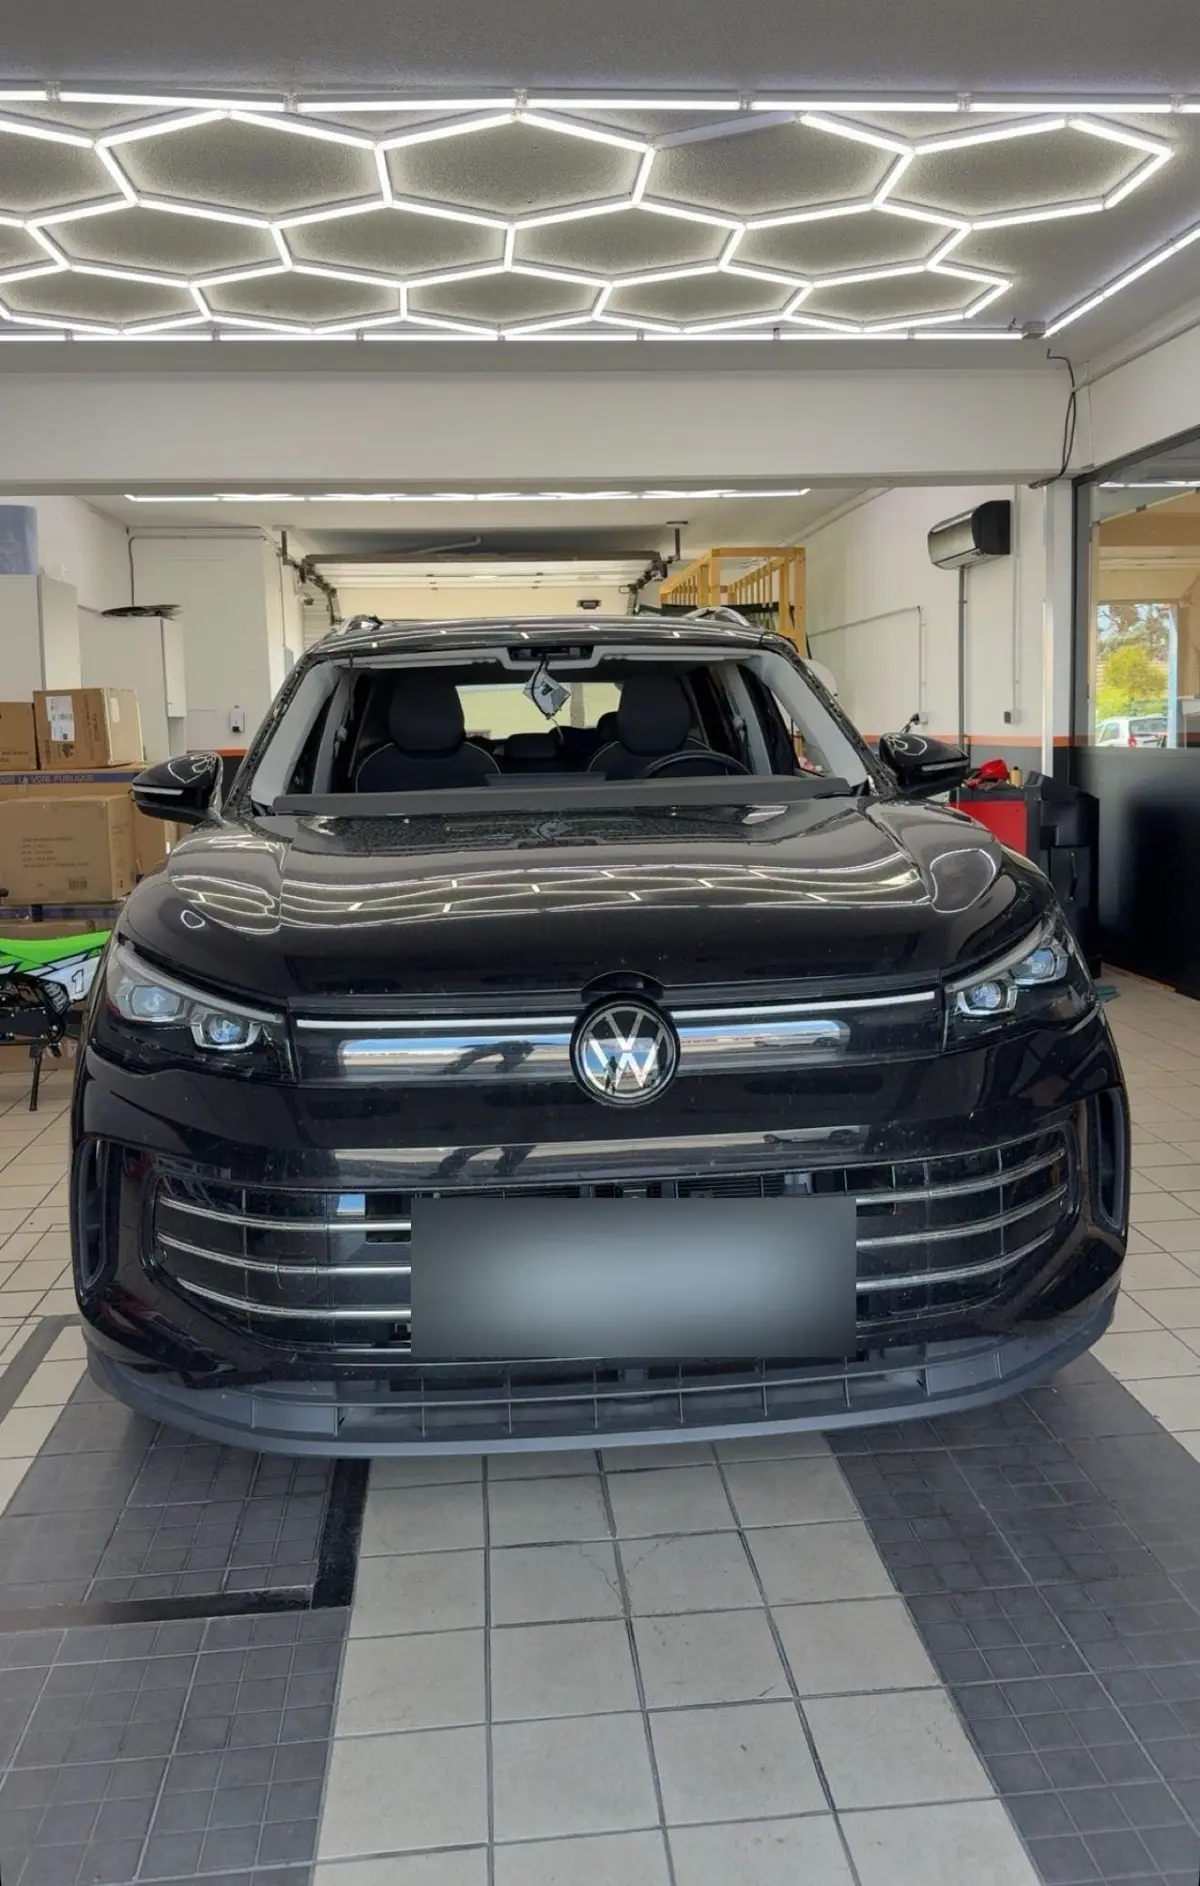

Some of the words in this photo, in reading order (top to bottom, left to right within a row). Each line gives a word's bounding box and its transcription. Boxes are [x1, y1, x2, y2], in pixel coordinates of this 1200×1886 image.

[55, 773, 95, 782] PUBLIQUE
[71, 969, 84, 994] 1
[581, 1006, 672, 1097] VW
